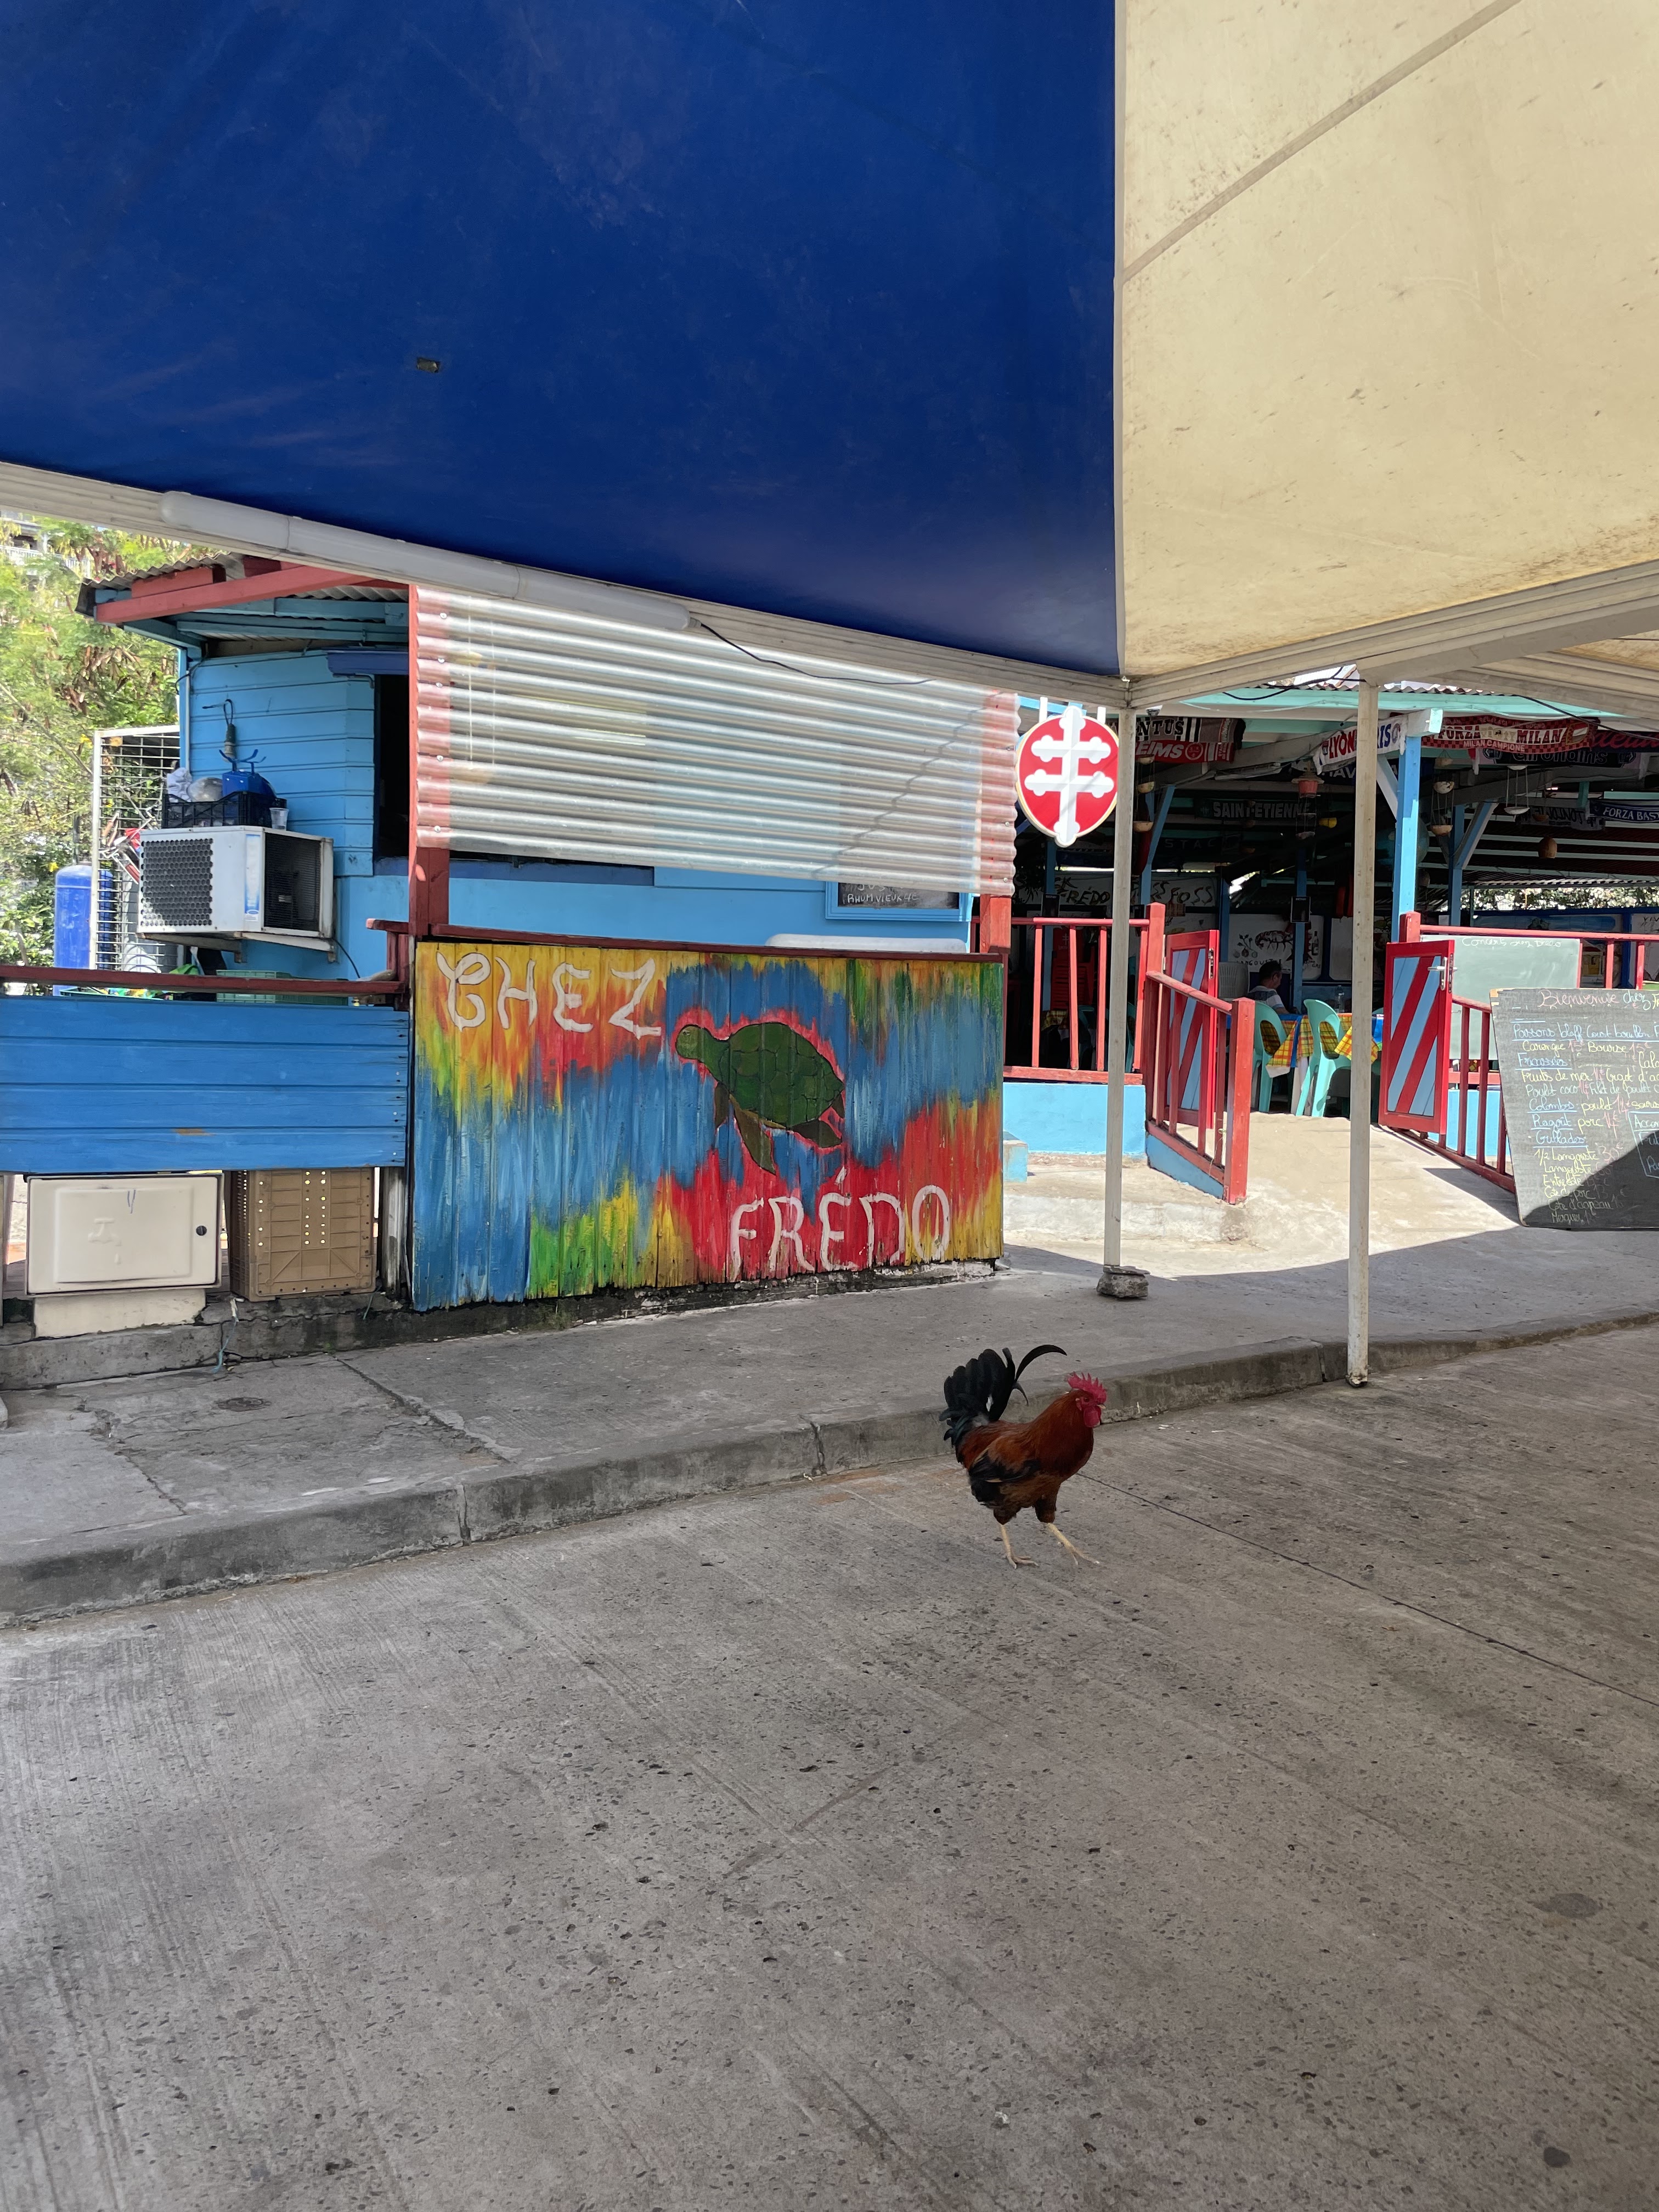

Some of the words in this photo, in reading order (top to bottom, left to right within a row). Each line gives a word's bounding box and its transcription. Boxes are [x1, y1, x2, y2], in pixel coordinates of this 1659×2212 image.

[1438, 726, 1481, 740] FORZA
[1516, 729, 1564, 744] MILAN
[1136, 741, 1184, 759] EIMS
[1329, 730, 1356, 759] LYON
[1487, 740, 1525, 752] CAMPIONE
[1603, 807, 1634, 820] FORZA
[847, 893, 873, 904] RHUM
[436, 951, 662, 1040] CHEZ
[1537, 990, 1621, 1007] Bienvenue
[1555, 1068, 1568, 1082] de
[1610, 1081, 1621, 1094] de
[1577, 1118, 1604, 1135] porc
